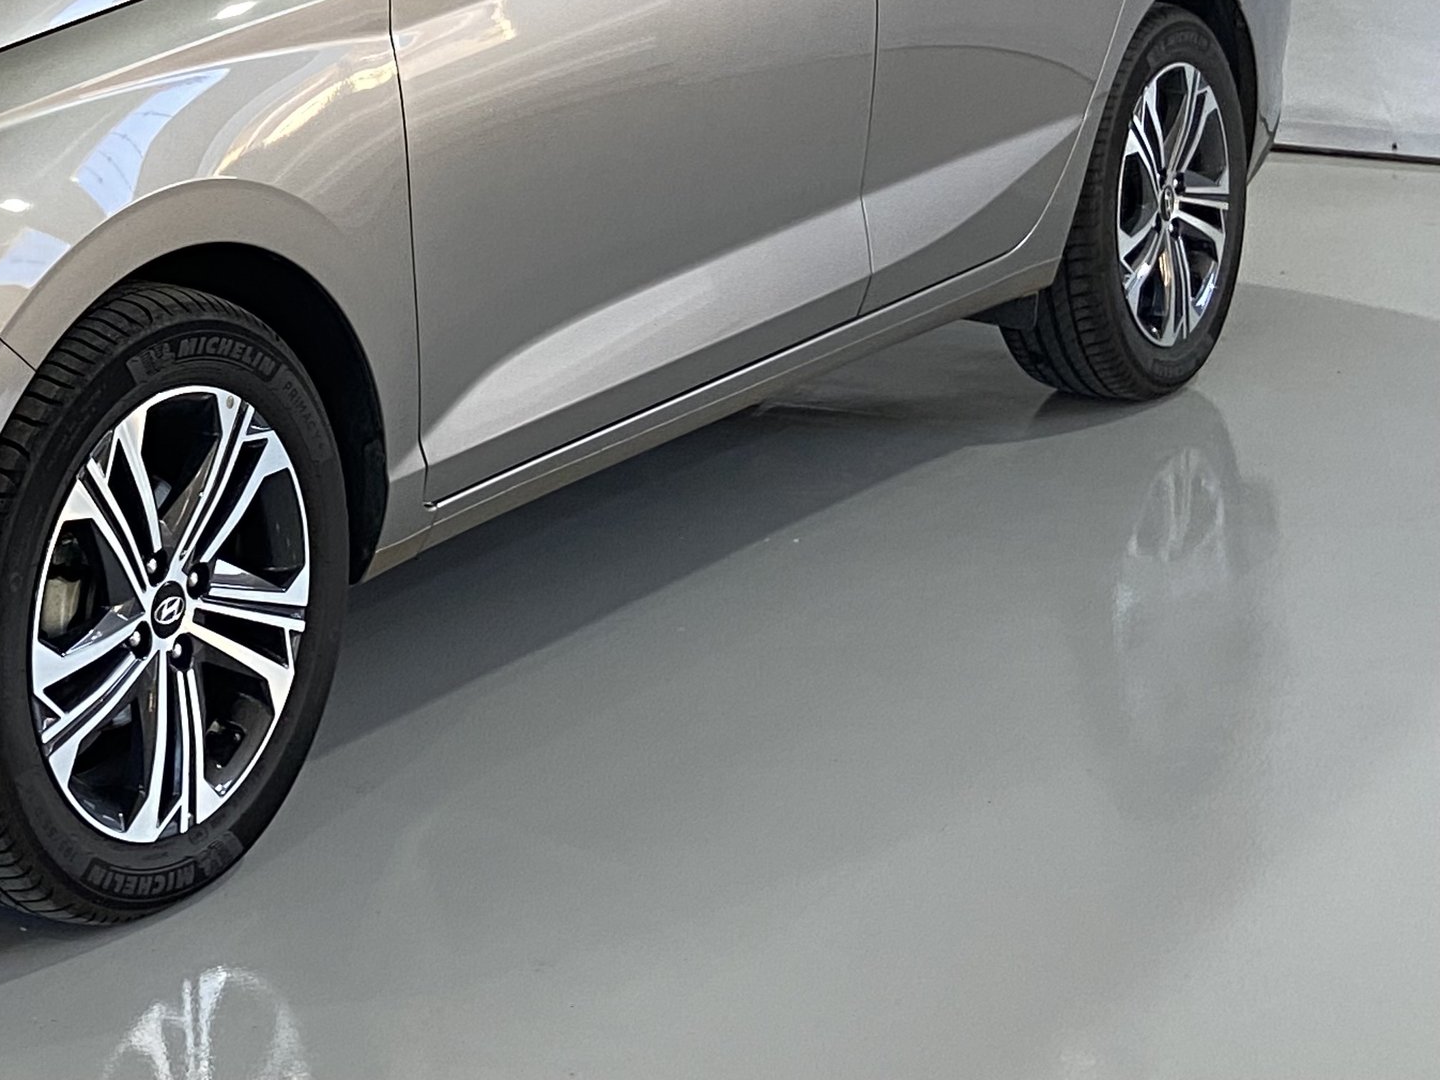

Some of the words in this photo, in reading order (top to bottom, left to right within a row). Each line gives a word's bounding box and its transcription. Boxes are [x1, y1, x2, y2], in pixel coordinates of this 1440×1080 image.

[176, 336, 277, 377] MICHELIN
[282, 380, 322, 440] PRIMACY
[87, 863, 196, 897] MICHELIN
